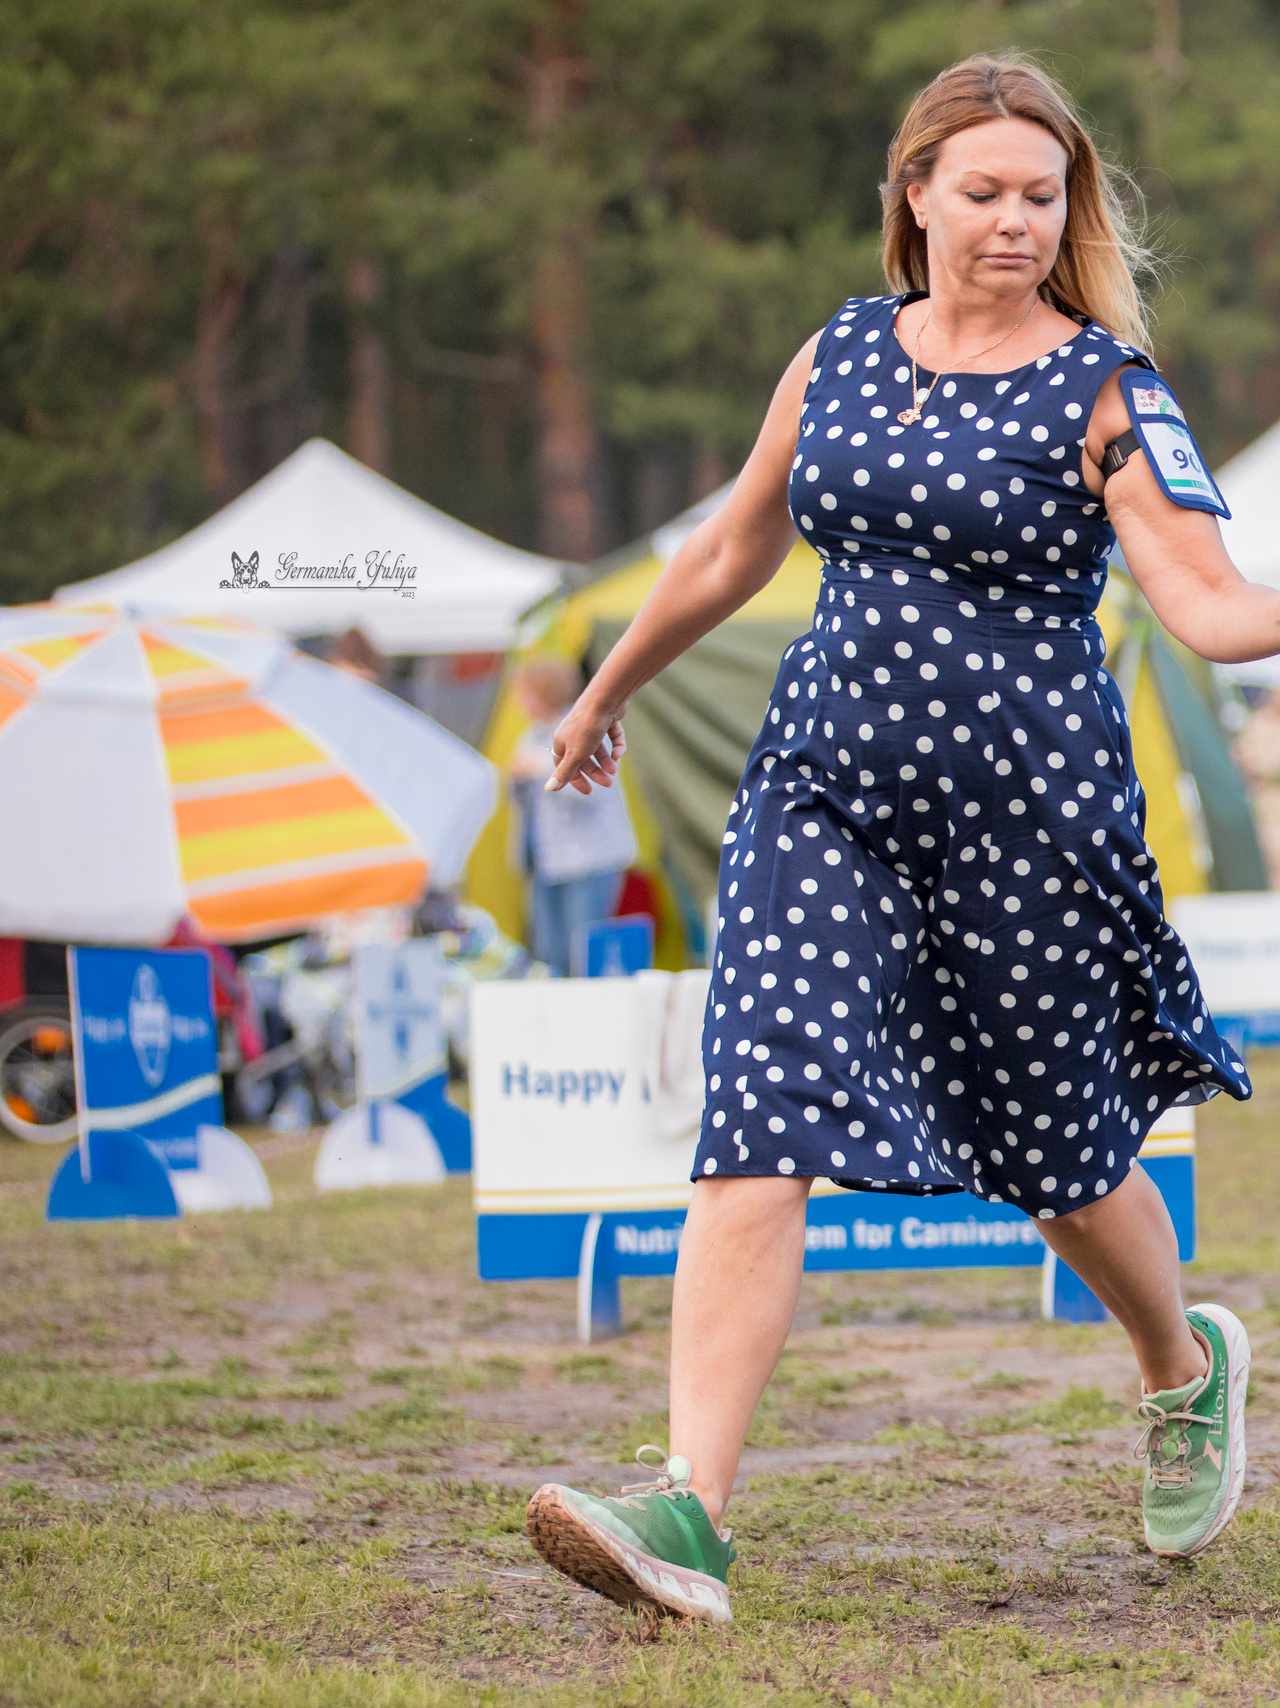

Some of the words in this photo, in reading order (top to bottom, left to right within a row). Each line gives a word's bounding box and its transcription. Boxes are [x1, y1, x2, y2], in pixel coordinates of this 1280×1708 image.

[1171, 448, 1202, 474] 90
[502, 1061, 627, 1105] Happy
[853, 1218, 895, 1250] for
[1207, 1355, 1227, 1436] Etonic
